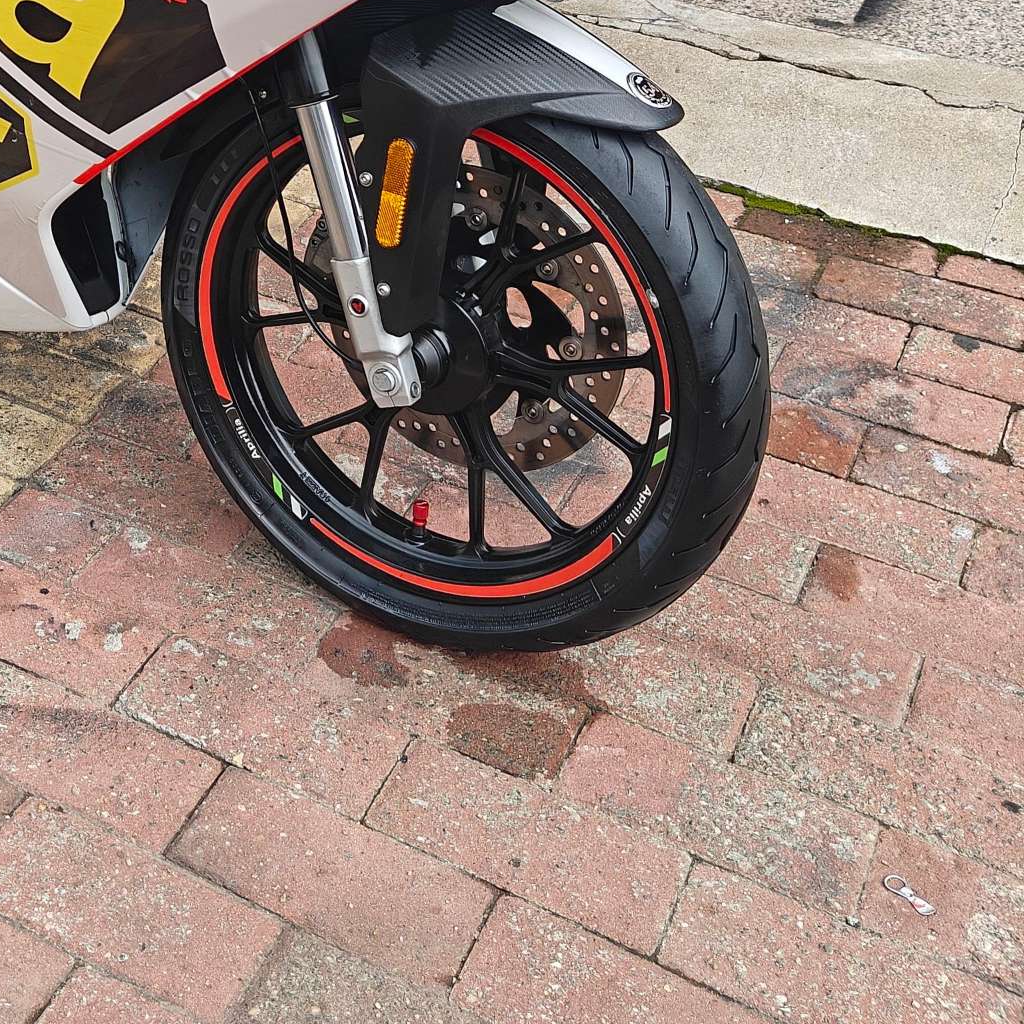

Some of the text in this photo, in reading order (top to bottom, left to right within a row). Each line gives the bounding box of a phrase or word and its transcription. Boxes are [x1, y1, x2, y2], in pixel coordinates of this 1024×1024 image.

[177, 217, 201, 302] ROSSO
[233, 417, 262, 460] Aprilia
[624, 484, 653, 526] Aprilia
